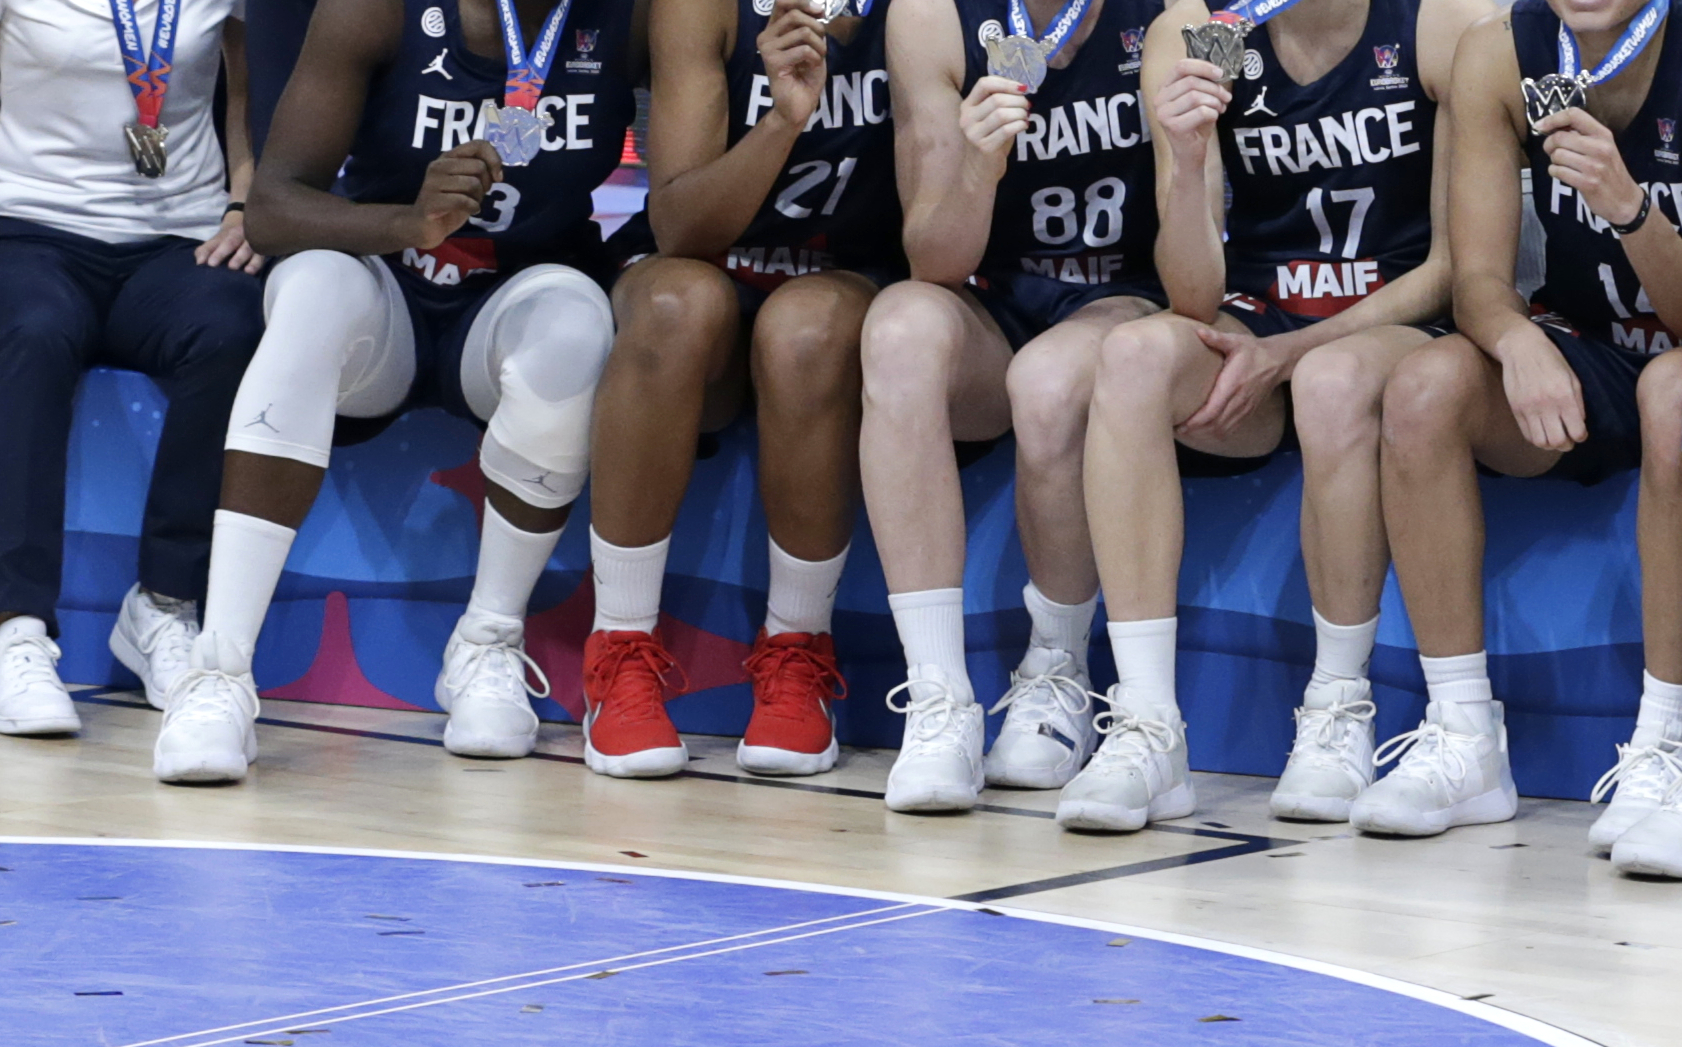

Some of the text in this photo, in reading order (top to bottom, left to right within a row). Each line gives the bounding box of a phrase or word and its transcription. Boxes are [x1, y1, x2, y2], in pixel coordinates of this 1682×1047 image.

[1232, 100, 1420, 176] FRANCE
[774, 157, 858, 219] 21
[1030, 177, 1126, 247] 88
[1306, 186, 1376, 259] 17
[1019, 254, 1125, 285] MAIF
[1276, 261, 1378, 300] MAIF
